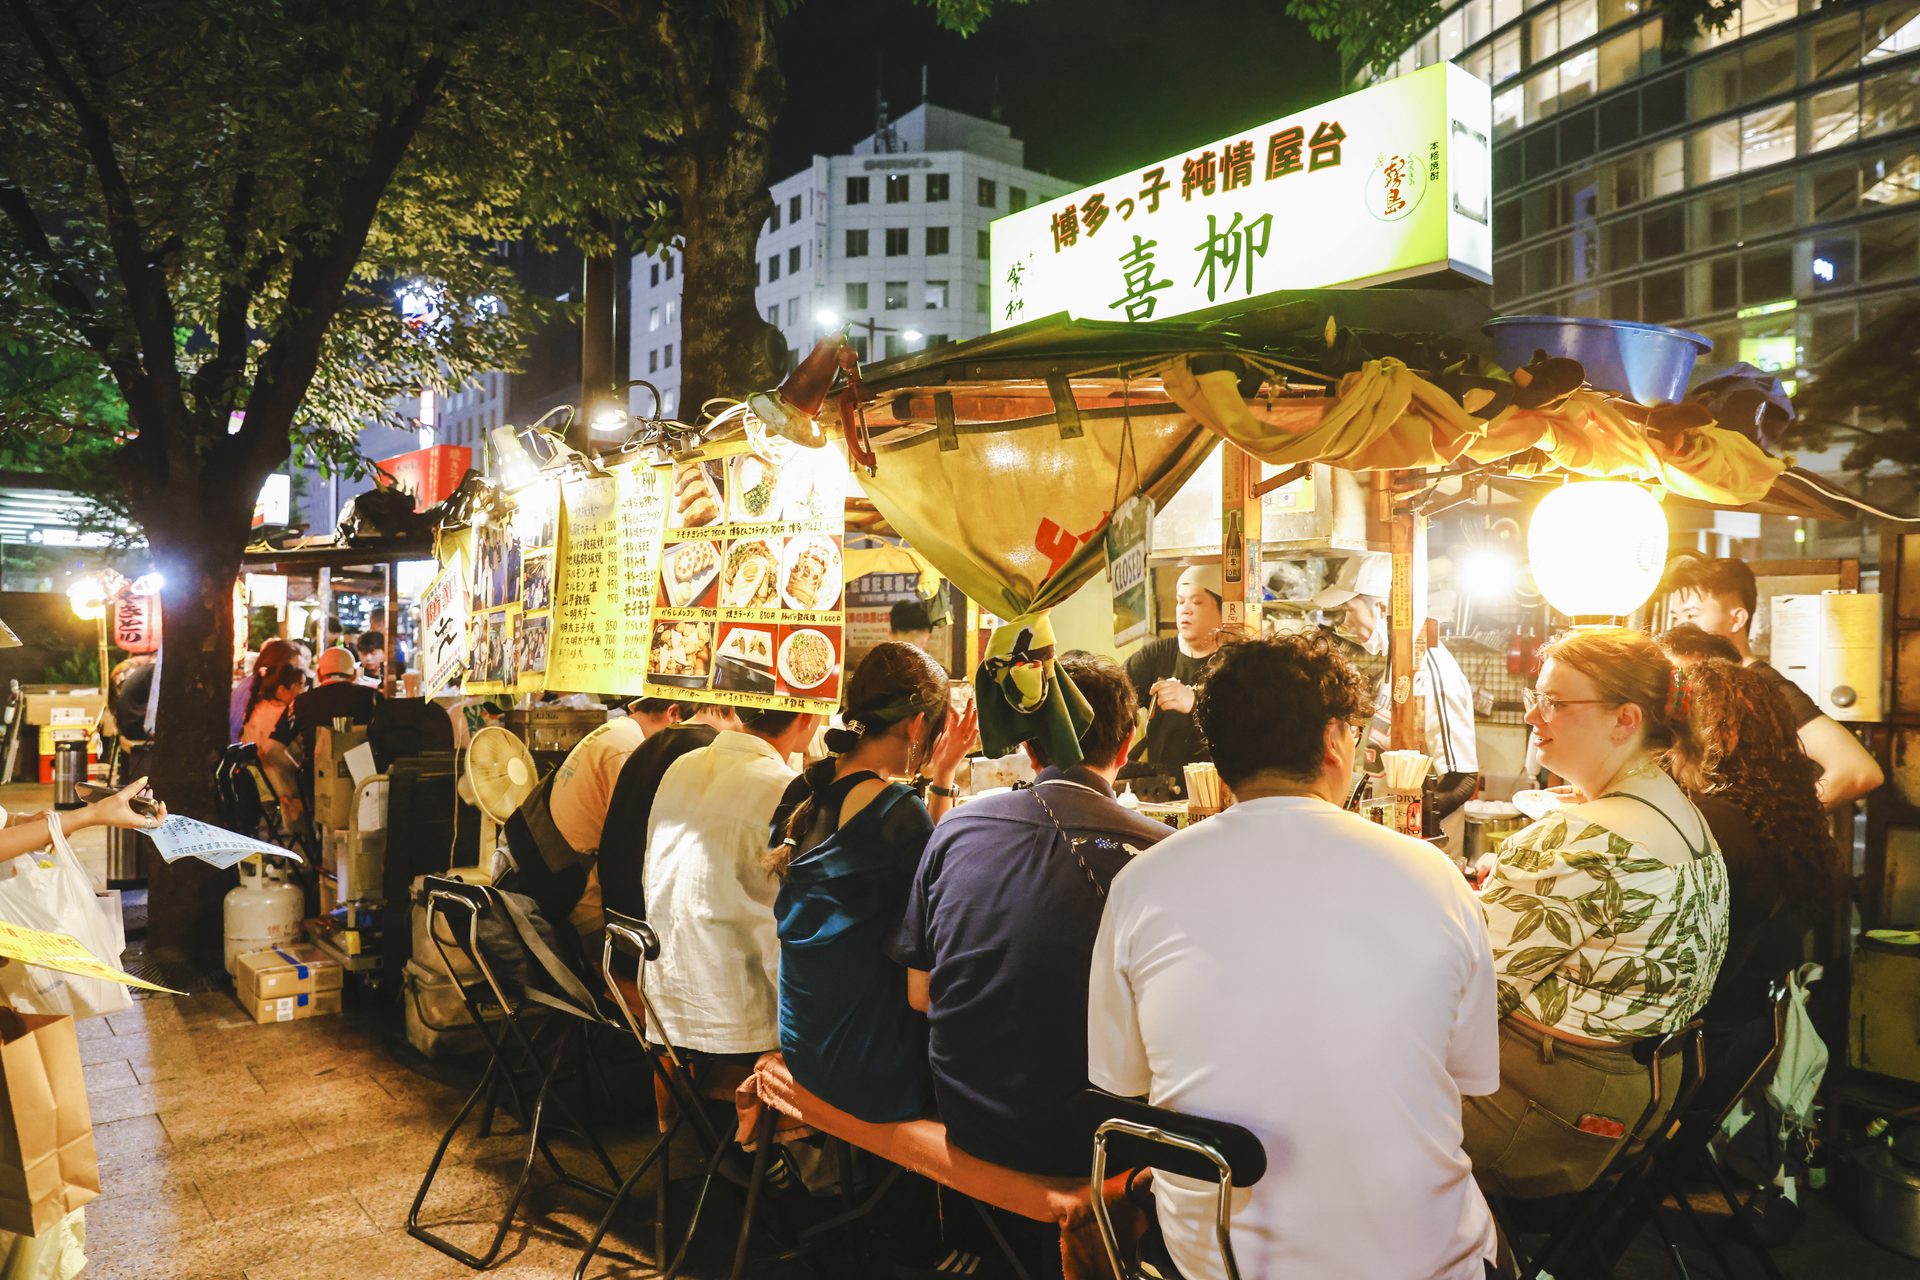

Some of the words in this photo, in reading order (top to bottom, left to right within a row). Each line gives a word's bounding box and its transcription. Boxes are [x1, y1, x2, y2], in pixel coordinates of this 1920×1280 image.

[1430, 141, 1440, 181] 本格焼酎
[1384, 155, 1406, 216] 霧島
[1108, 211, 1274, 322] 喜柳
[1114, 549, 1142, 593] CLOSED
[605, 619, 618, 632] 850
[759, 610, 776, 620] 850円
[1229, 603, 1236, 613] R
